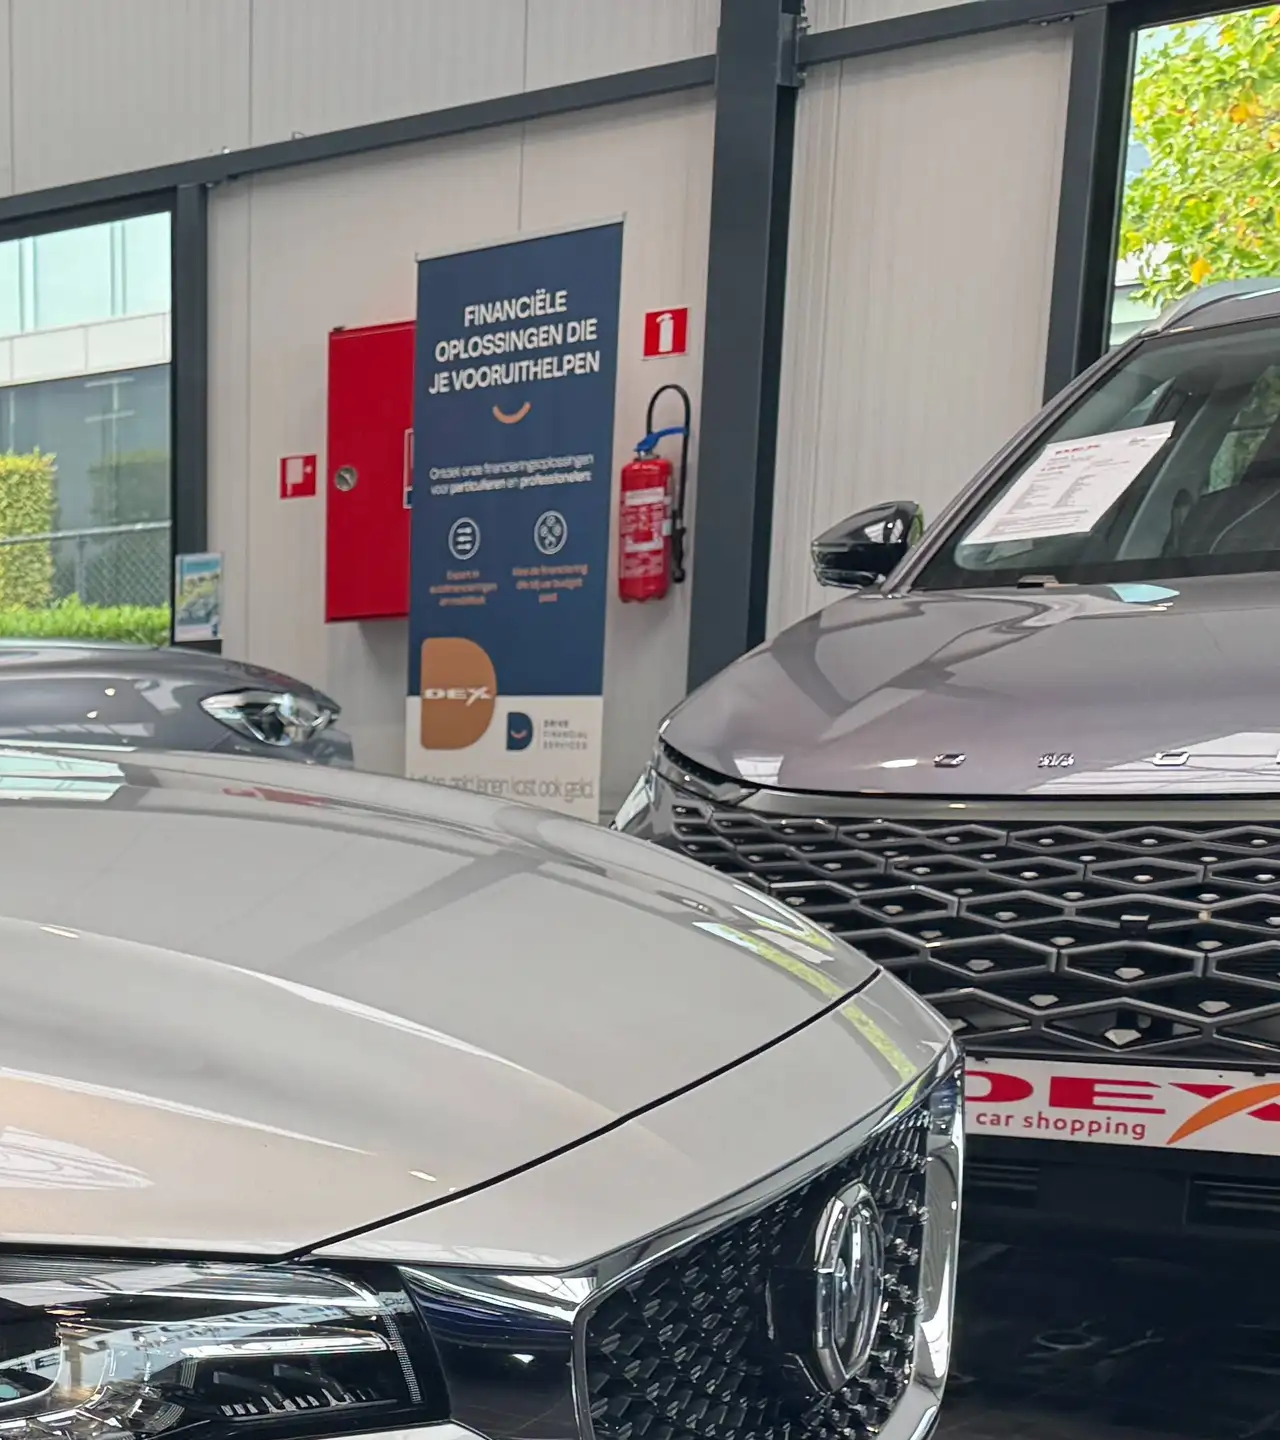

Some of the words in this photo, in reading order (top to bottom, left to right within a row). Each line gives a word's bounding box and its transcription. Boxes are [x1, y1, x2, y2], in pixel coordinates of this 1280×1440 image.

[464, 289, 567, 327] FINANCIËLE
[434, 324, 563, 363] OPLOSSINGEN
[566, 318, 598, 344] DIE
[428, 370, 451, 395] JE
[451, 351, 601, 391] VOORUITHELPEN
[423, 686, 493, 707] DEX
[976, 1112, 1014, 1127] car
[1023, 1111, 1146, 1140] shopping
